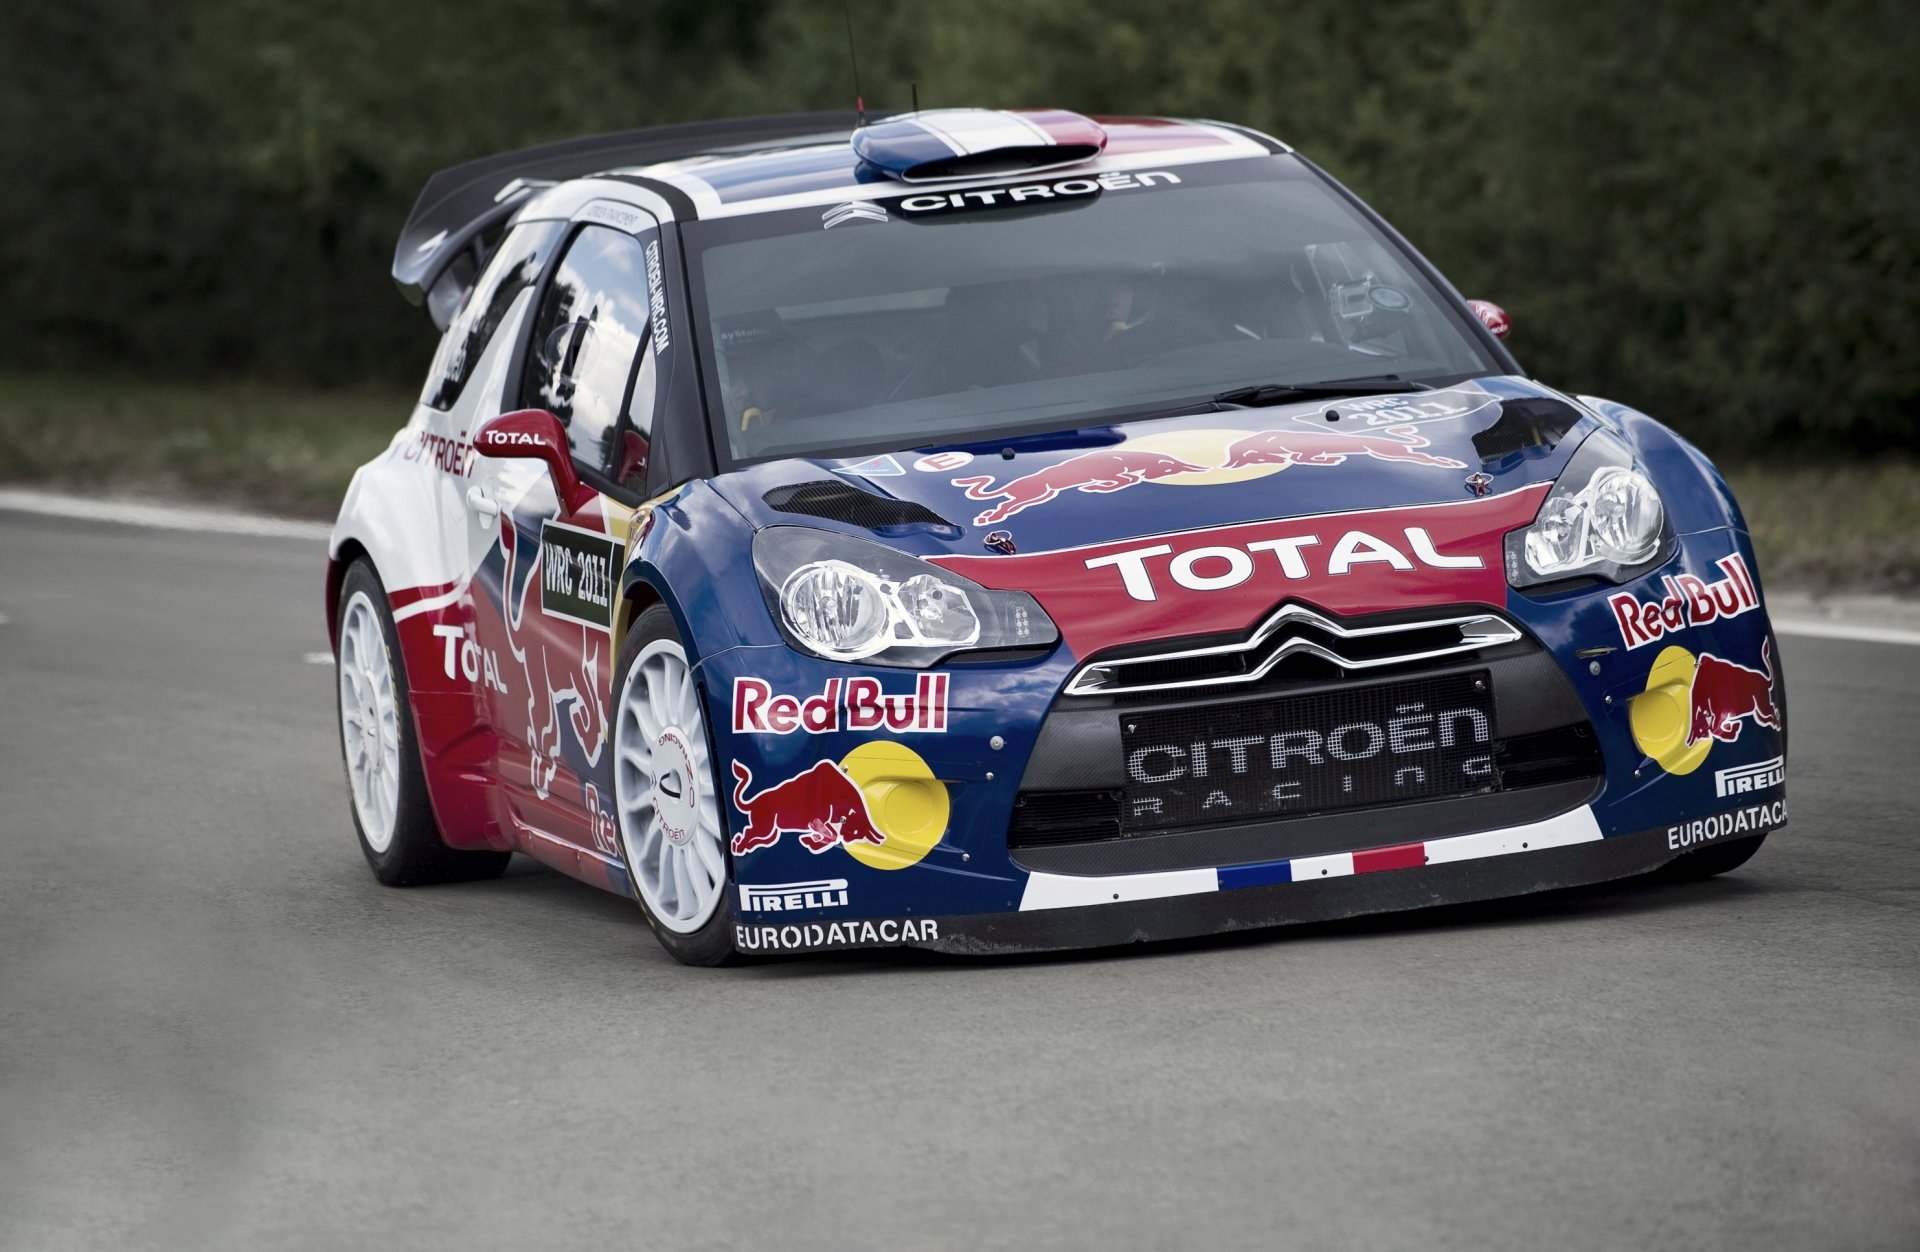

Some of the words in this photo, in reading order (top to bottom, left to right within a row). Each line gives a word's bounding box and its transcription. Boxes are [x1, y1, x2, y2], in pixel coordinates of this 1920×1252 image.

[1339, 397, 1410, 412] WRC
[1347, 401, 1469, 426] 2011
[486, 429, 547, 446] TOTAL
[544, 542, 574, 596] WRC
[577, 551, 608, 608] 2011
[1083, 526, 1486, 602] TOTAL
[1607, 574, 1686, 652] Red
[1674, 551, 1760, 627] Bull
[432, 624, 509, 695] TOTAL
[732, 676, 843, 735] Red
[844, 672, 950, 734] Bull
[1667, 798, 1788, 851] EURODATACA
[738, 878, 849, 912] PIRELLI
[735, 919, 939, 950] EURODATACAR
